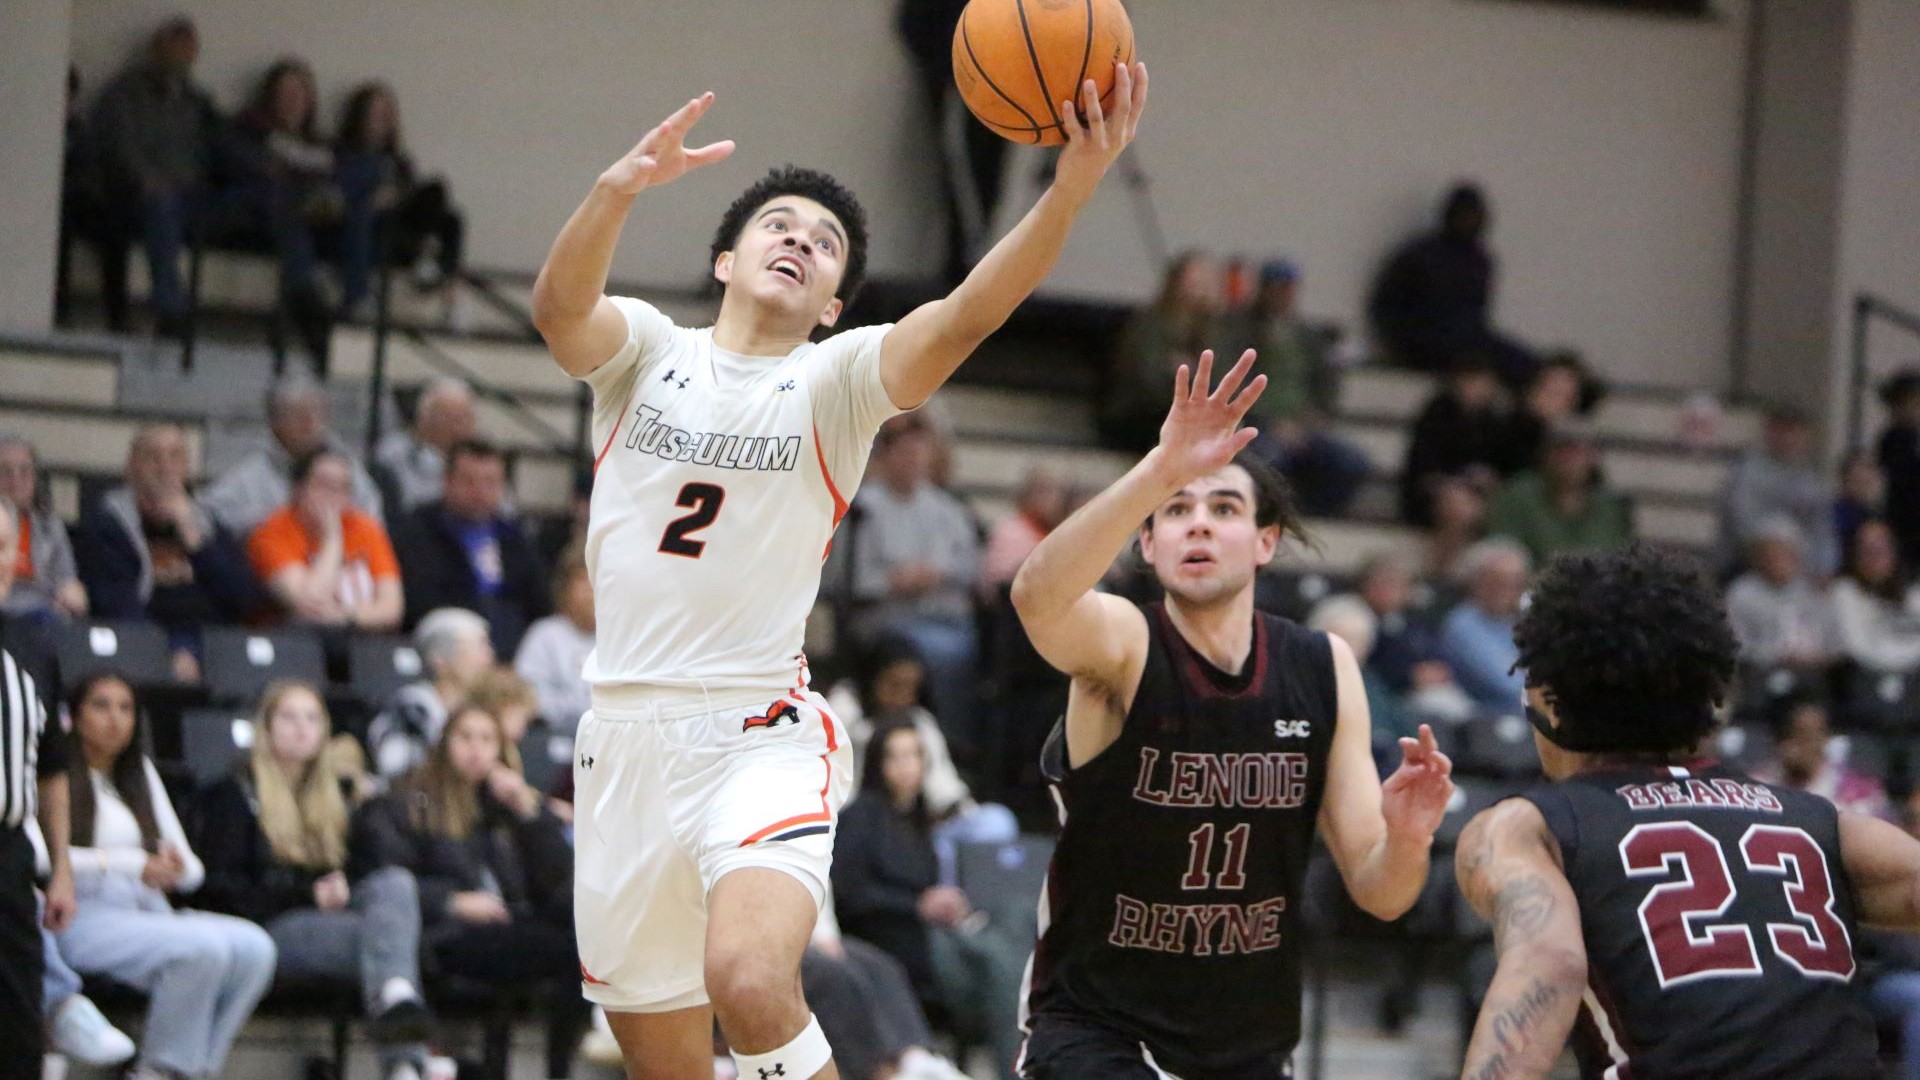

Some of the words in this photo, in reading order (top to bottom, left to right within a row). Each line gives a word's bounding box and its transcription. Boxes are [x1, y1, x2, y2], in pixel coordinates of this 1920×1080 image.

[656, 482, 726, 559] 2
[1273, 719, 1311, 738] SAC
[1615, 778, 1784, 813] BEARS
[1181, 822, 1251, 891] 11
[1108, 893, 1287, 956] RHYNE
[1618, 820, 1856, 989] 23
